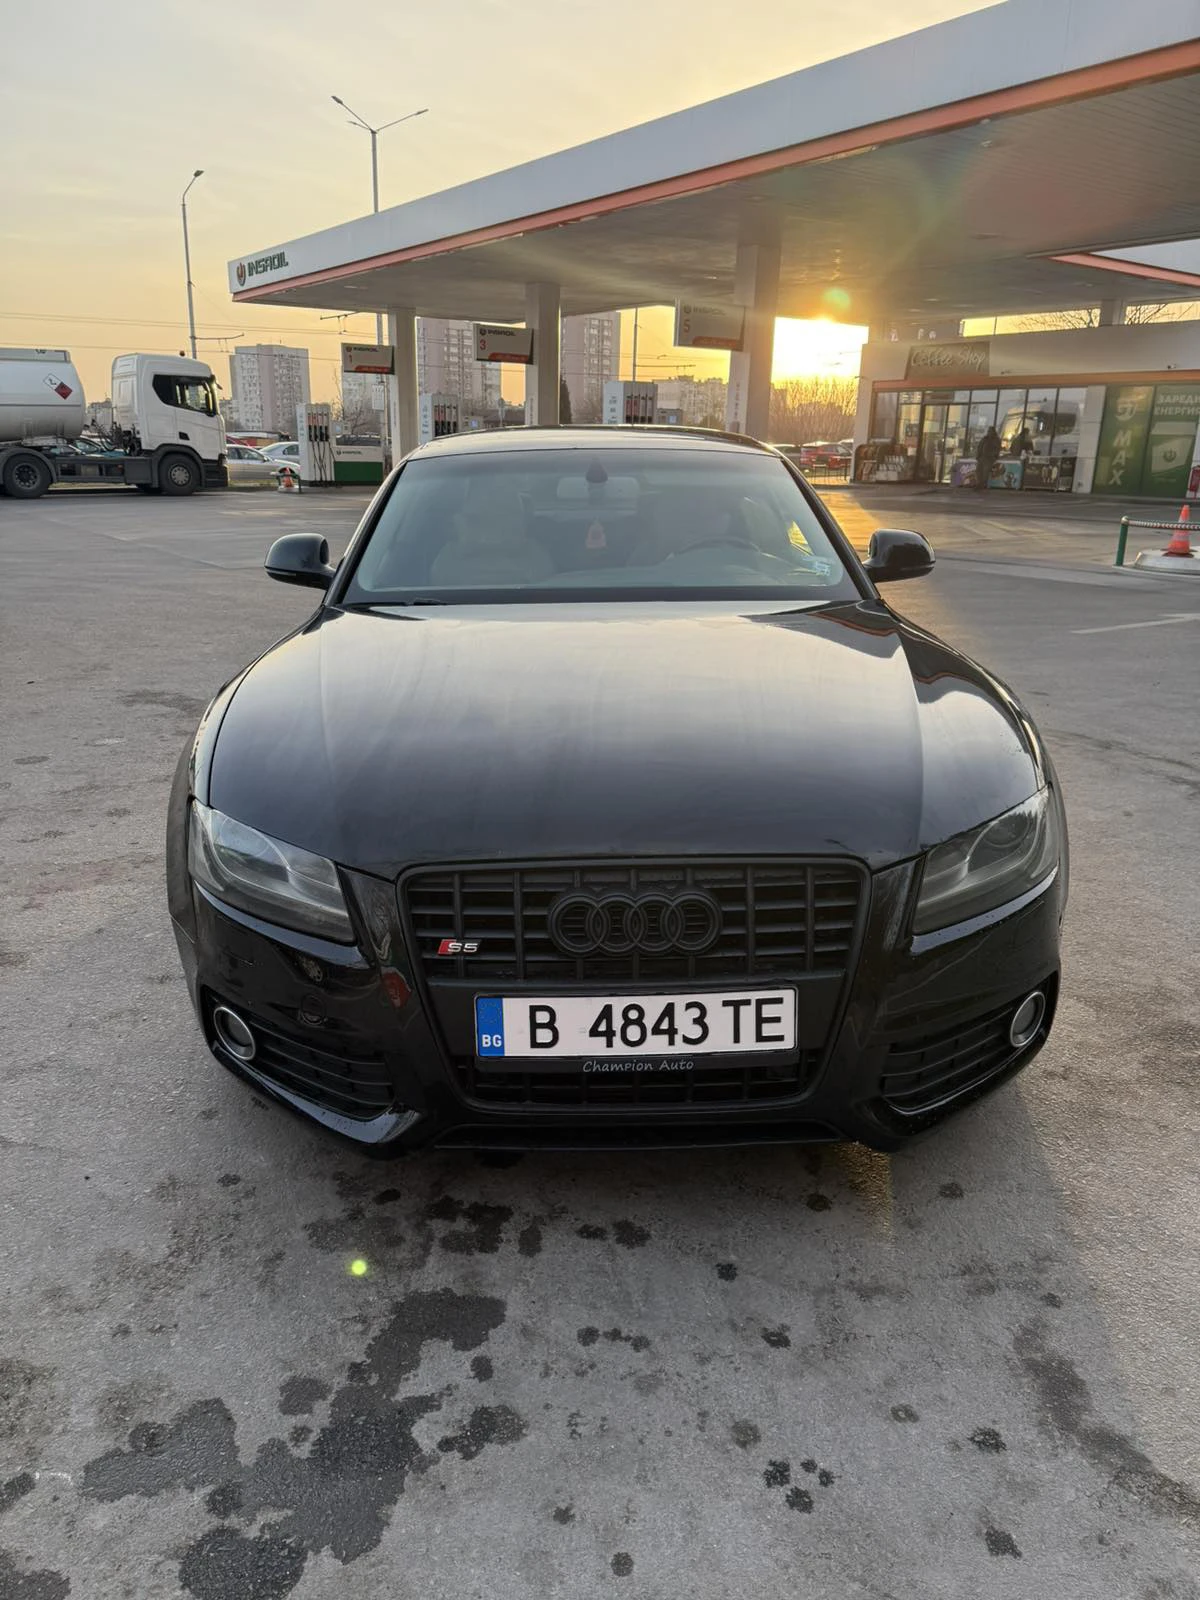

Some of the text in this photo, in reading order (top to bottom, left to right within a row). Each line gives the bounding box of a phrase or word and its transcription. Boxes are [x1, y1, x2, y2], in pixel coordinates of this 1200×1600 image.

[480, 339, 487, 350] 3
[447, 942, 479, 953] S5
[529, 996, 785, 1049] B 4843 TE
[482, 1034, 502, 1048] BG
[582, 1058, 695, 1073] Champion Auto
